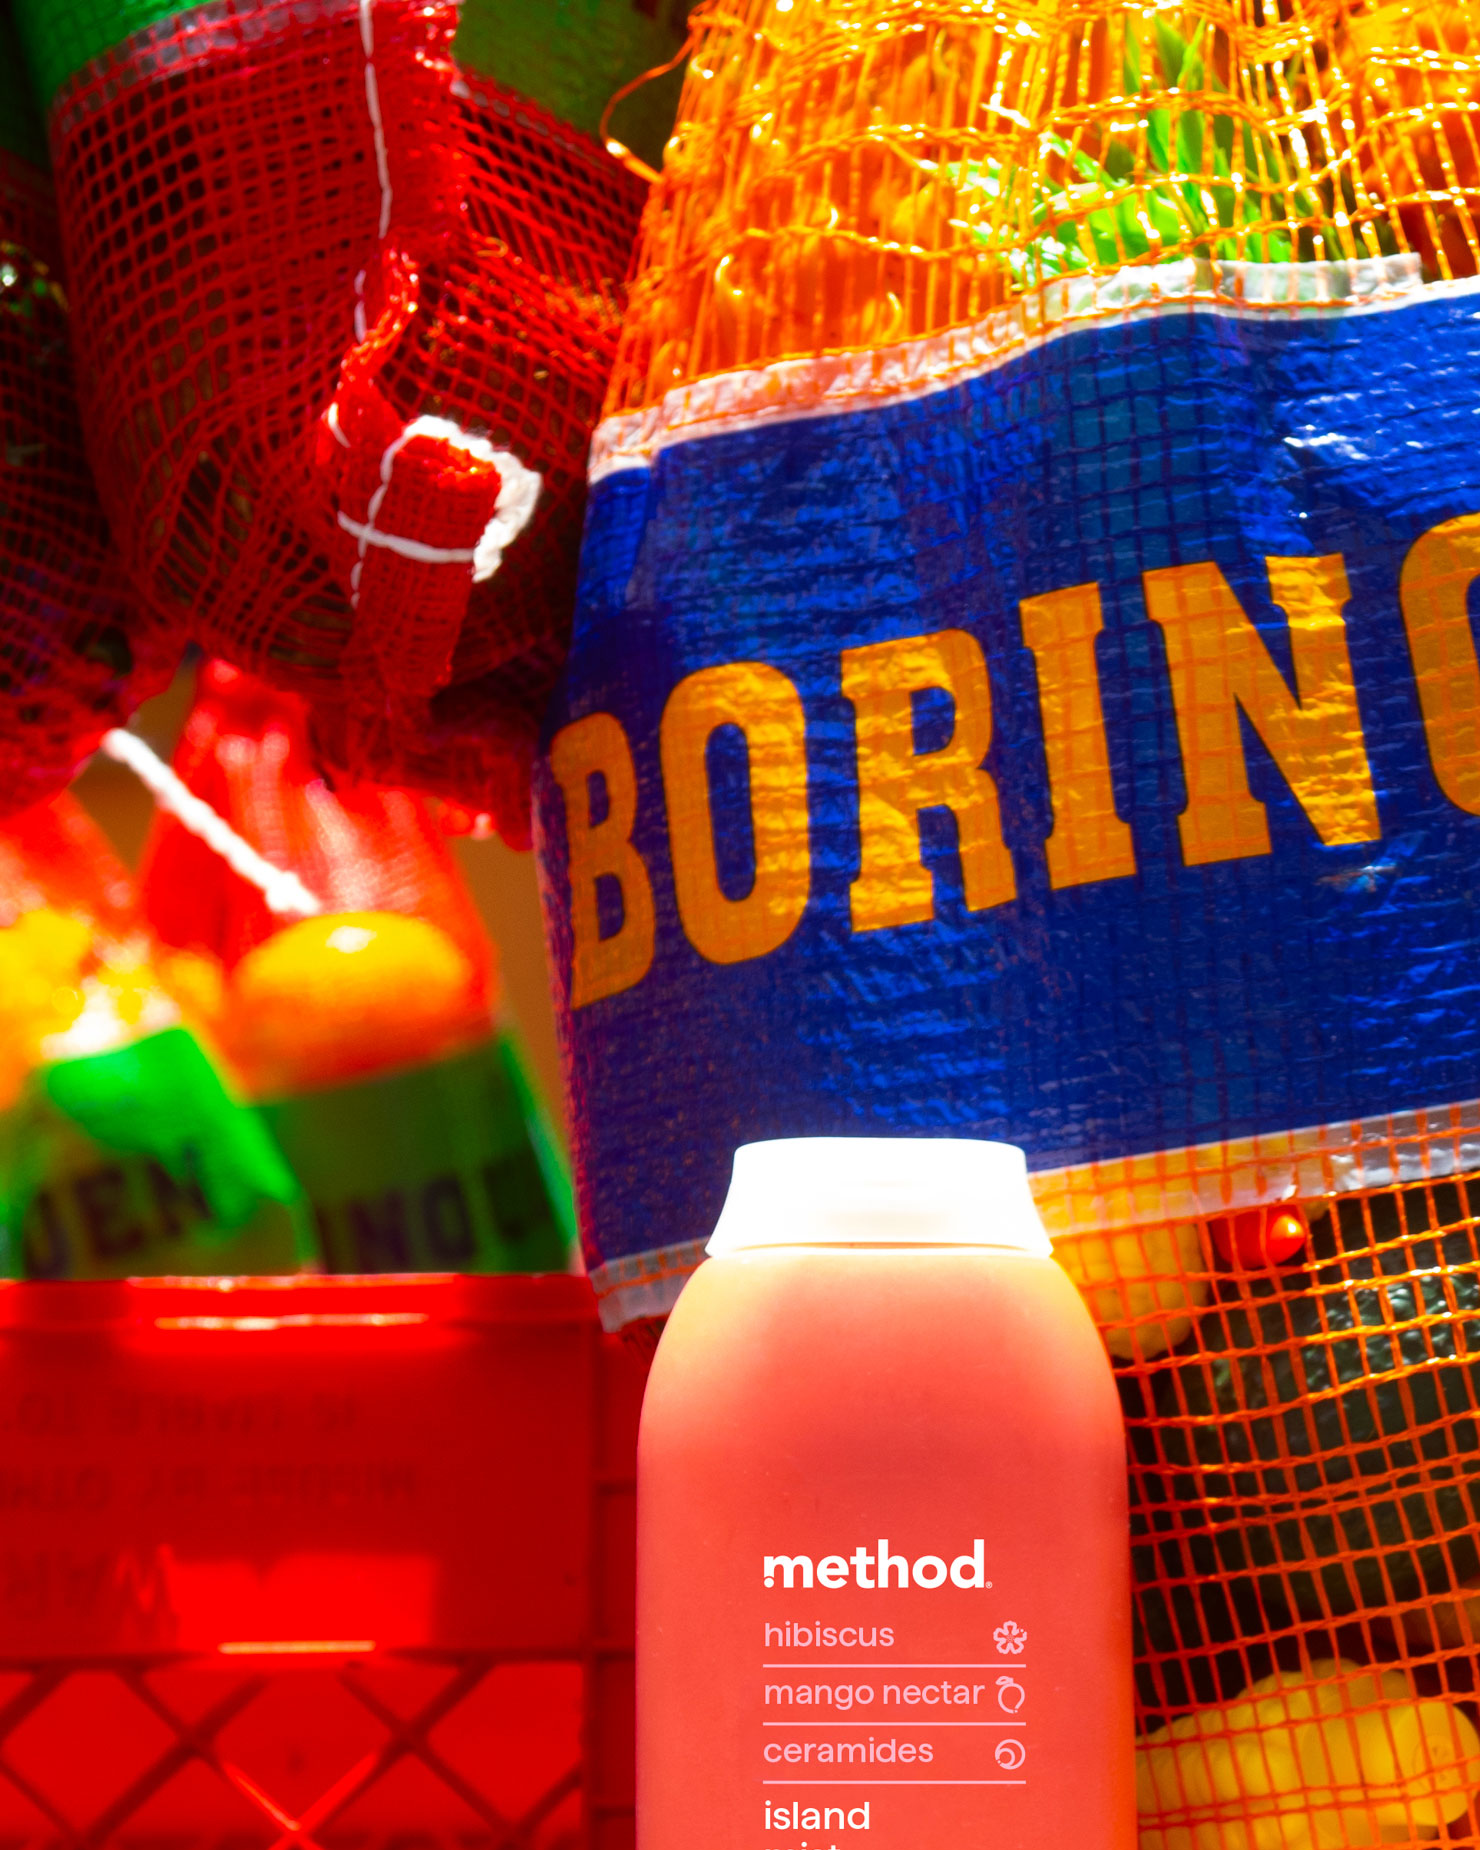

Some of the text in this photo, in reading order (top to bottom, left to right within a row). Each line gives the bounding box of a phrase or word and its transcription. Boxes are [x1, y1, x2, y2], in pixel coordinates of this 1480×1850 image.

[765, 1621, 894, 1647] hibiscus
[765, 1681, 985, 1710] mango nectar
[764, 1737, 933, 1762] ceramides
[765, 1800, 869, 1829] island
